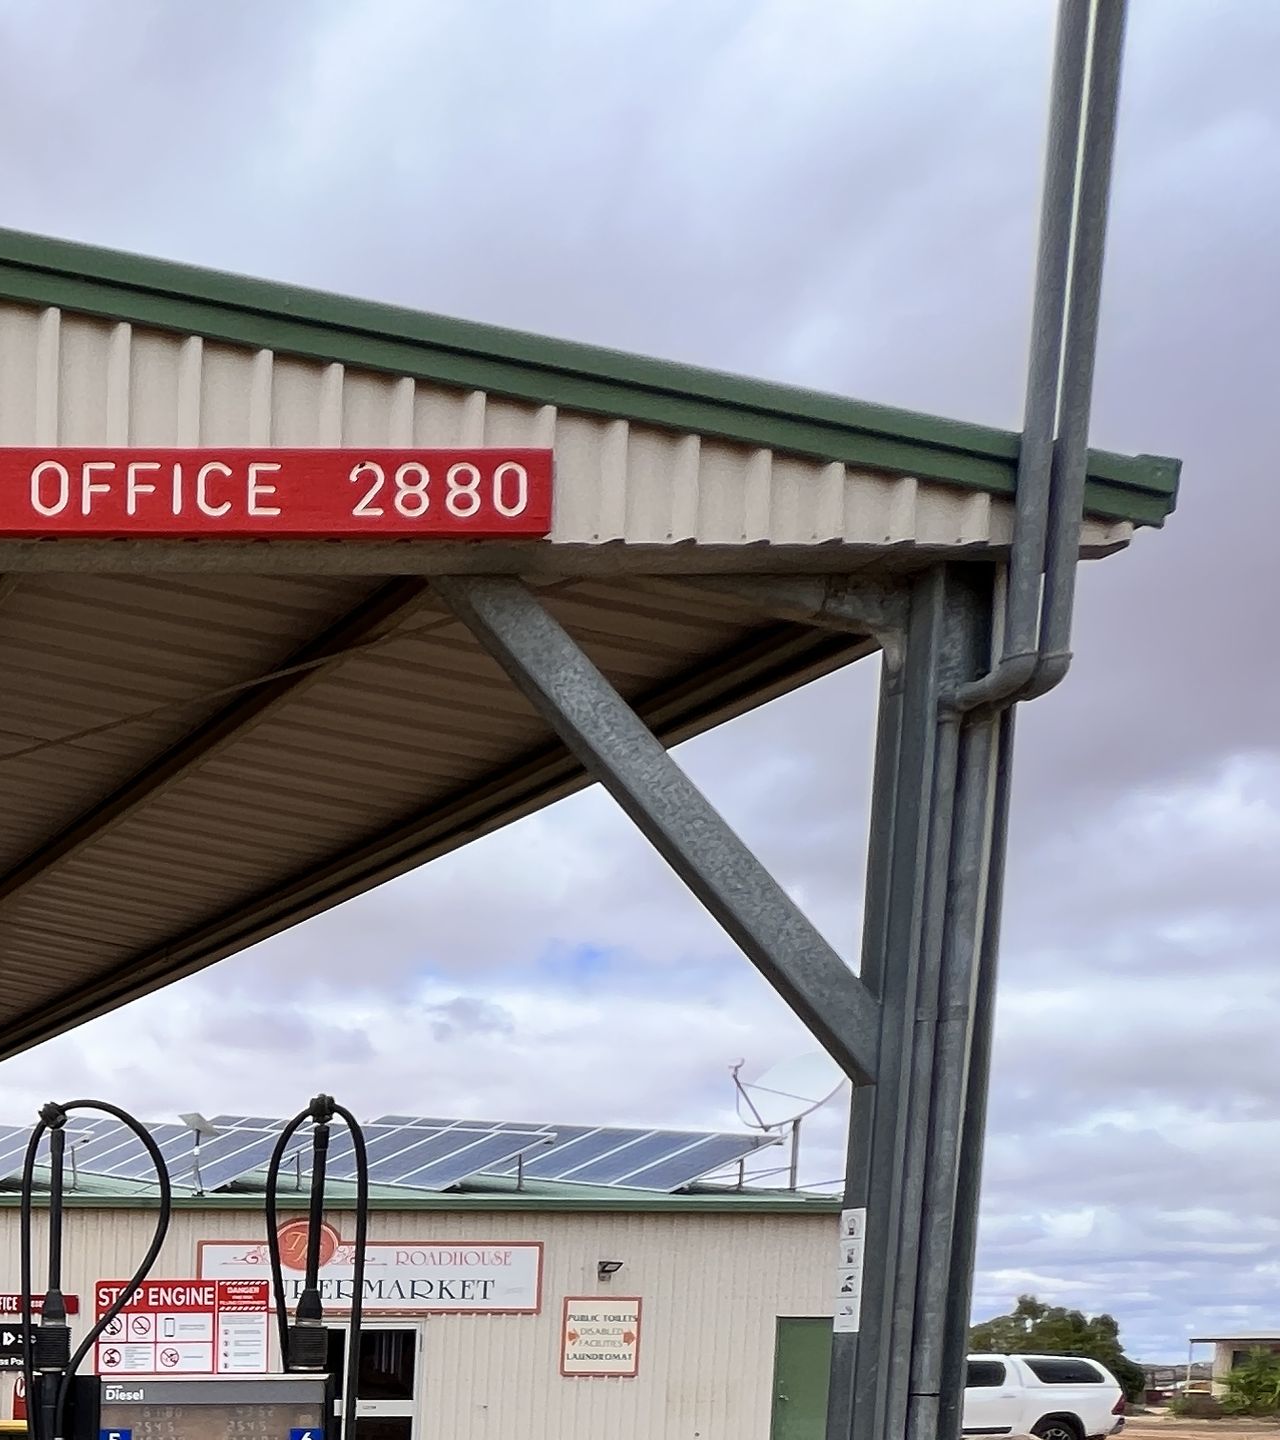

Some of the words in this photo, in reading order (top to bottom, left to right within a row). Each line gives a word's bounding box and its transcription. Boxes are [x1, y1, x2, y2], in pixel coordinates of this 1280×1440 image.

[30, 461, 283, 517] OFFICE
[348, 462, 529, 518] 2880
[395, 1250, 513, 1266] ROADHOUSE
[283, 1279, 496, 1300] ERMARKET
[148, 1287, 215, 1306] ENGINE
[568, 1314, 599, 1322] PUBLIC
[603, 1314, 638, 1322] TOILETS
[580, 1327, 623, 1336] DISABLED
[579, 1339, 623, 1348] FACILITIES
[10, 1357, 25, 1366] Poi
[566, 1353, 633, 1361] LAUNDROMAT
[105, 1389, 144, 1400] Diesel
